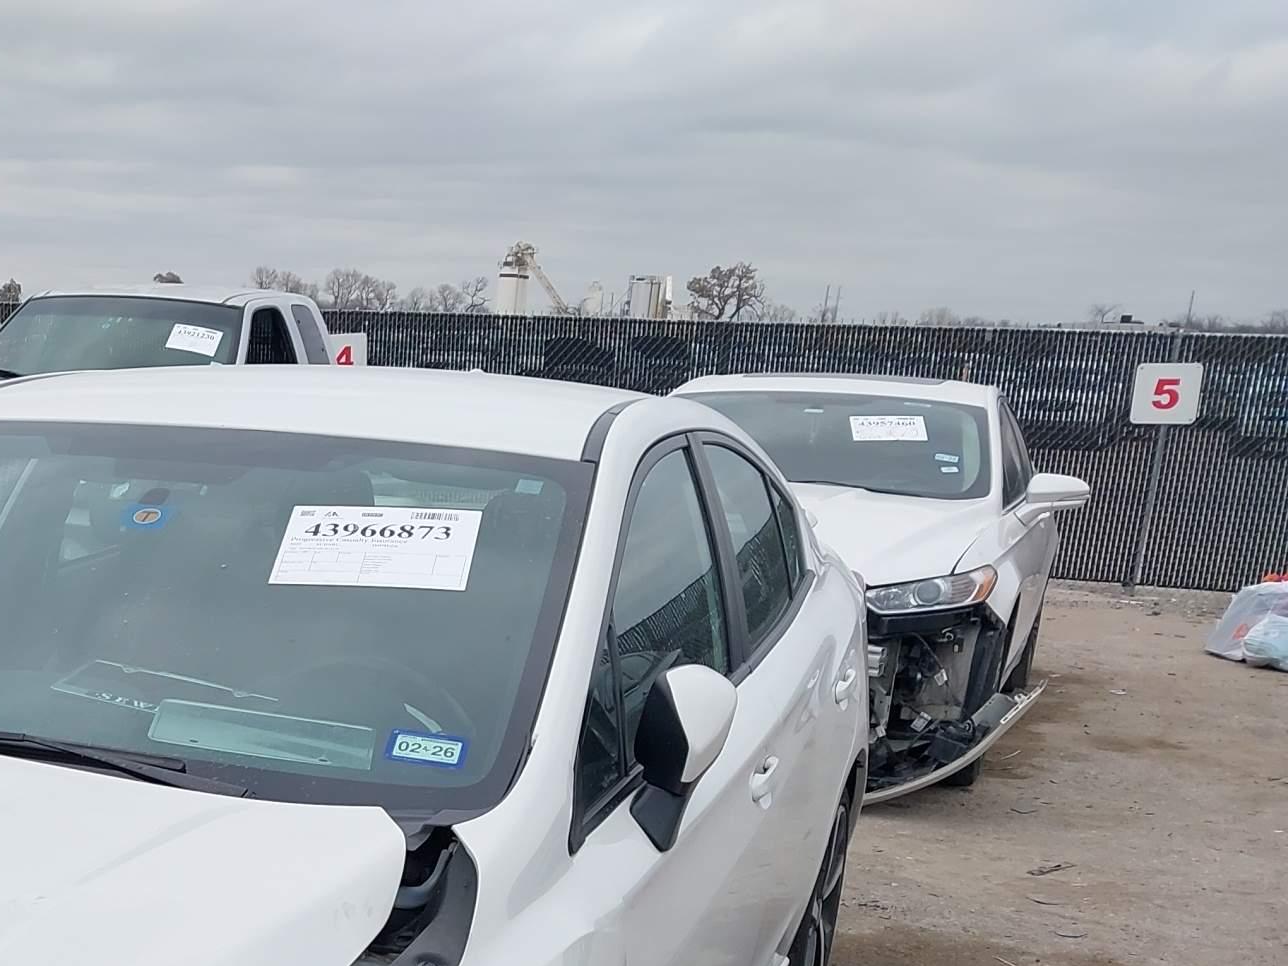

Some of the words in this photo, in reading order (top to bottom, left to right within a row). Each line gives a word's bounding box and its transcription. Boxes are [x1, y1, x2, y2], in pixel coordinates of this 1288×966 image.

[336, 345, 354, 366] 4
[1151, 378, 1181, 410] 5
[304, 522, 452, 540] 43966873
